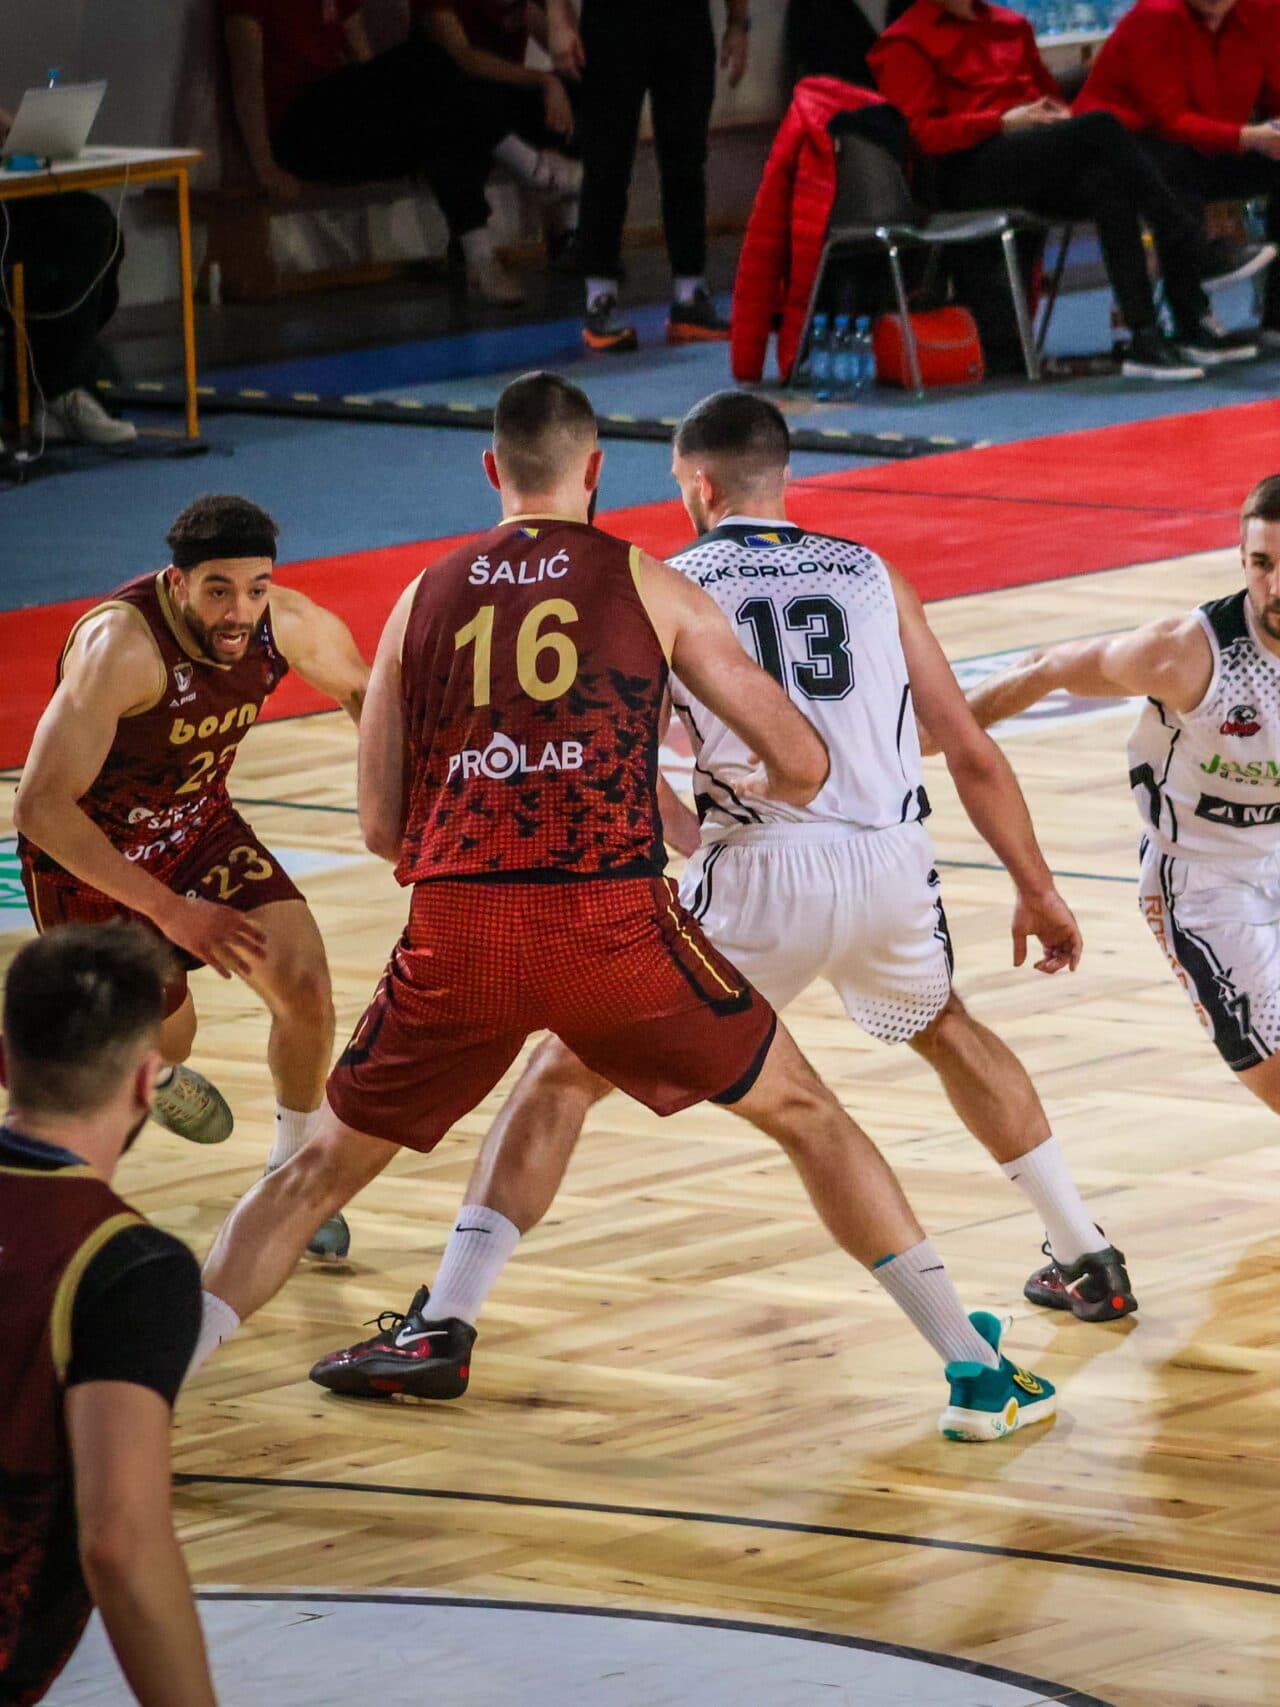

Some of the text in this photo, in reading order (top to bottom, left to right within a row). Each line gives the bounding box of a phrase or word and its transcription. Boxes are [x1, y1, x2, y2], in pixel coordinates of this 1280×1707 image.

[468, 549, 570, 585] ŠALIĆ
[698, 561, 860, 587] KK ORLOVIK
[455, 598, 579, 707] 16
[736, 594, 855, 701] 13
[446, 732, 584, 784] PROLAB
[202, 845, 273, 900] 23
